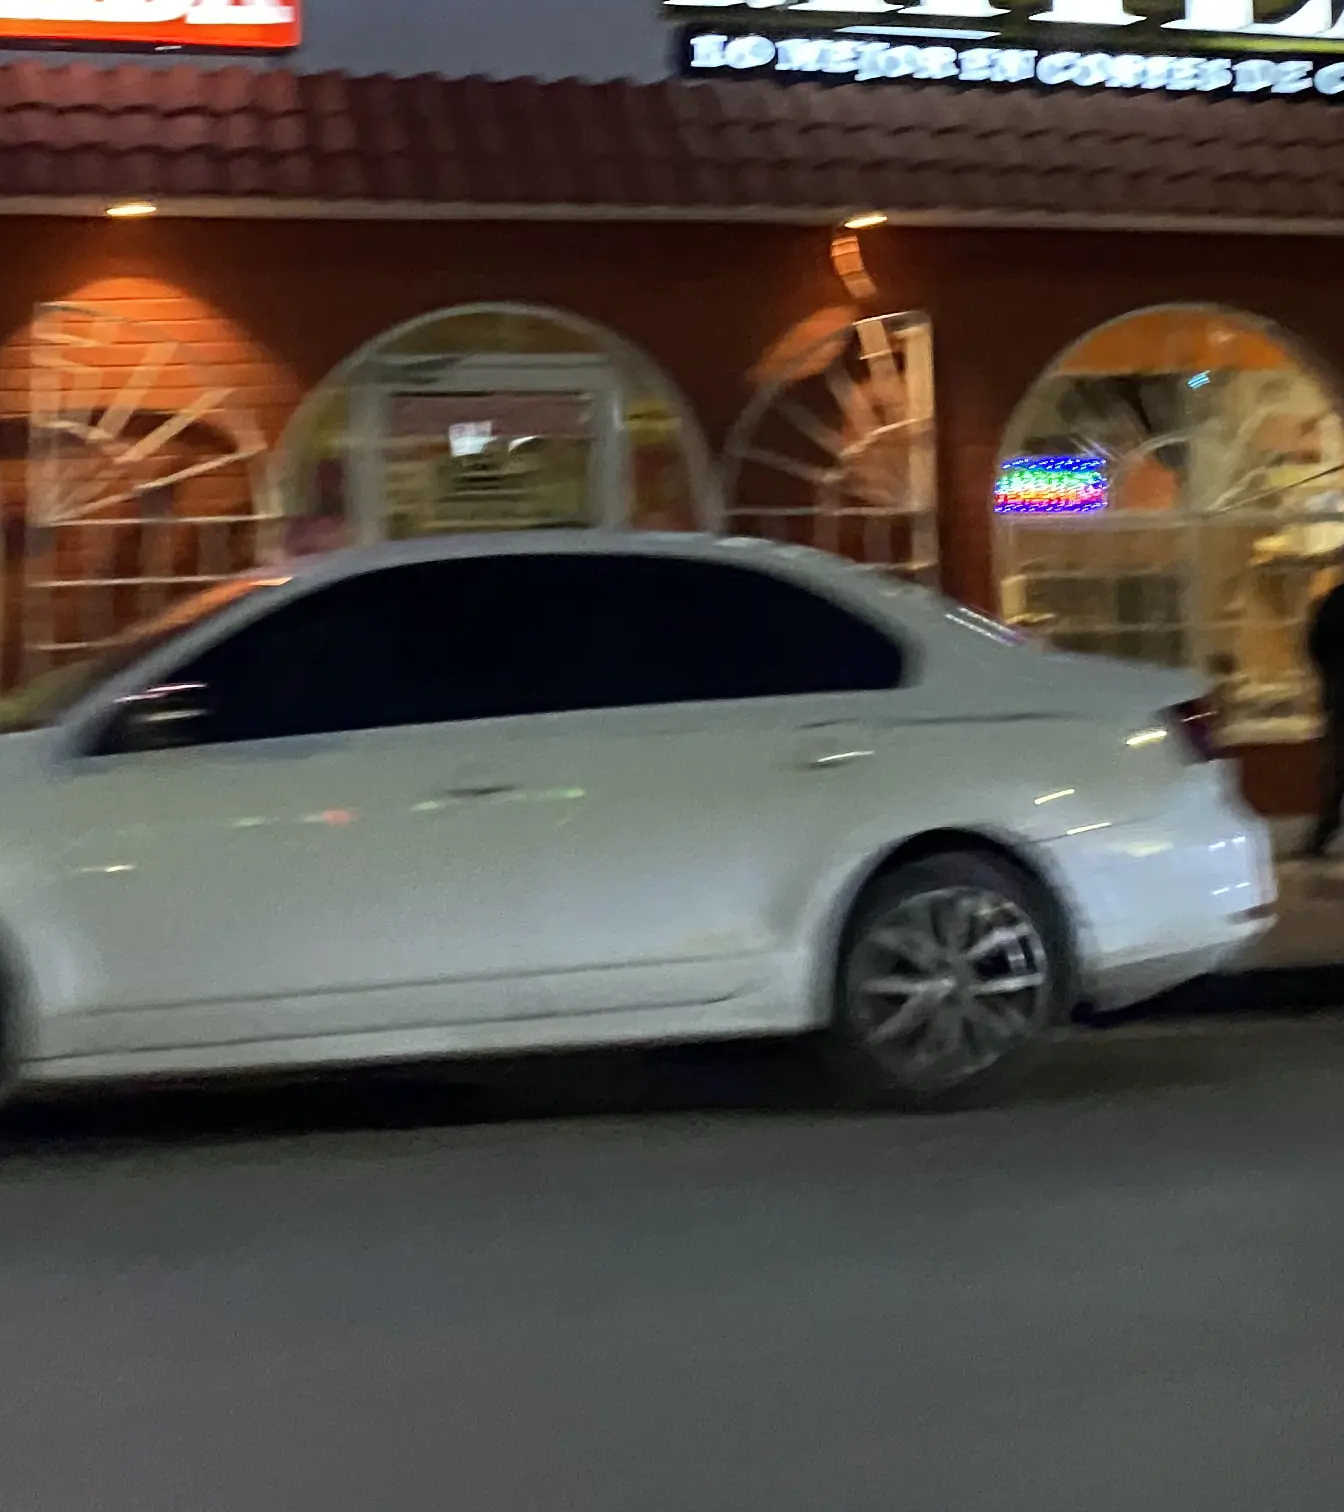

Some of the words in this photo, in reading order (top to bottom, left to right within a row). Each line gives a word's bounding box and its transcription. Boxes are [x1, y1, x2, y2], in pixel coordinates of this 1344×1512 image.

[690, 34, 776, 69] LO
[775, 38, 958, 81] MEJOR
[958, 47, 1038, 82] EN
[1232, 59, 1313, 93] DE
